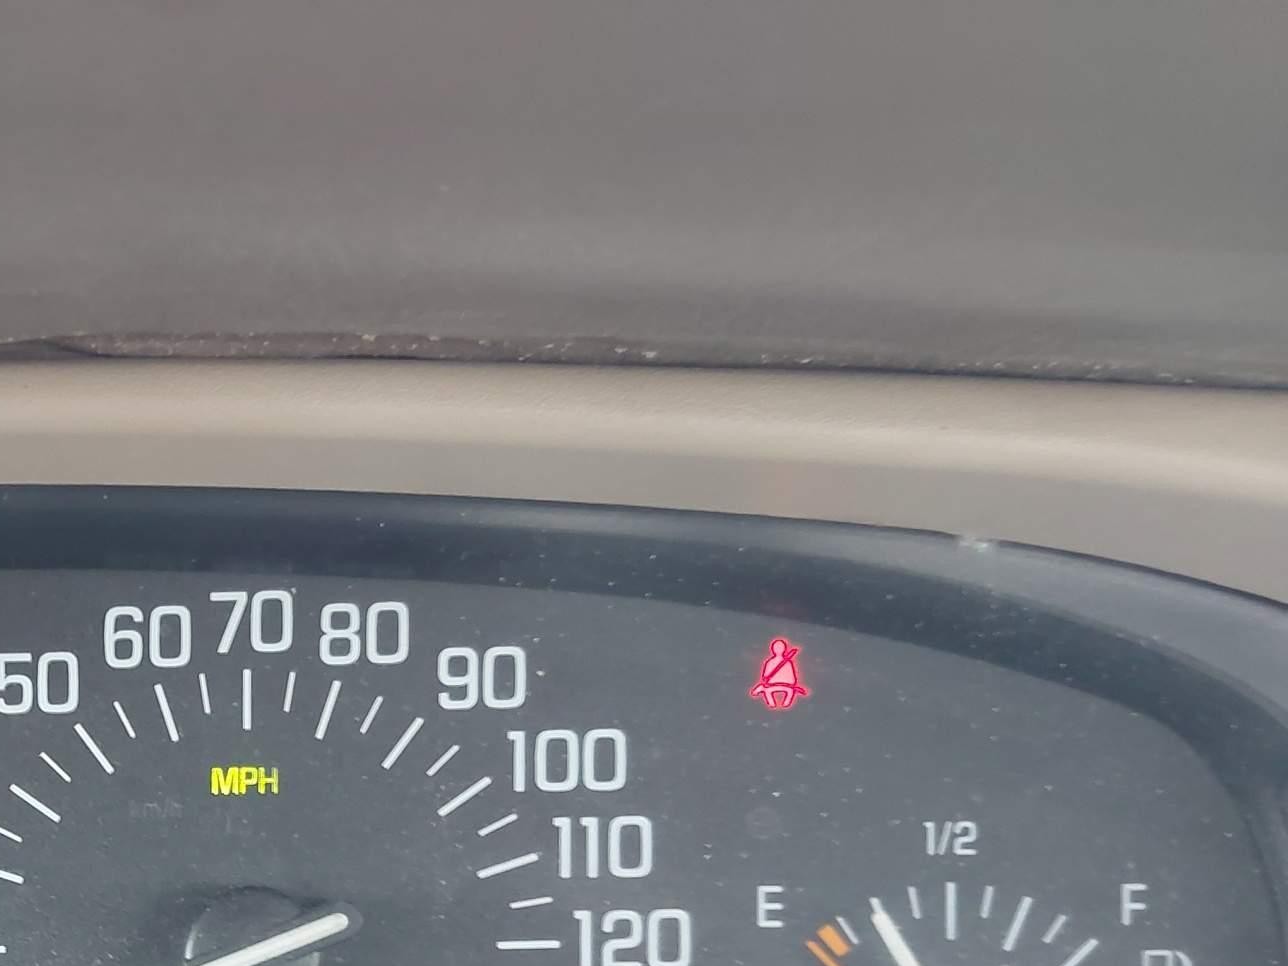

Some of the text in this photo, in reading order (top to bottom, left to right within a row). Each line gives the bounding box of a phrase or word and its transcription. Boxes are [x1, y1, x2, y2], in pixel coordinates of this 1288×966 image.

[103, 605, 192, 669] 60
[209, 589, 294, 654] 70
[319, 601, 410, 666] 80
[437, 645, 527, 710] 90
[211, 766, 279, 796] MPH
[507, 728, 627, 793] 100
[552, 815, 653, 879] 110
[923, 820, 977, 856] 1/2
[757, 885, 784, 928] E
[1121, 883, 1147, 926] F
